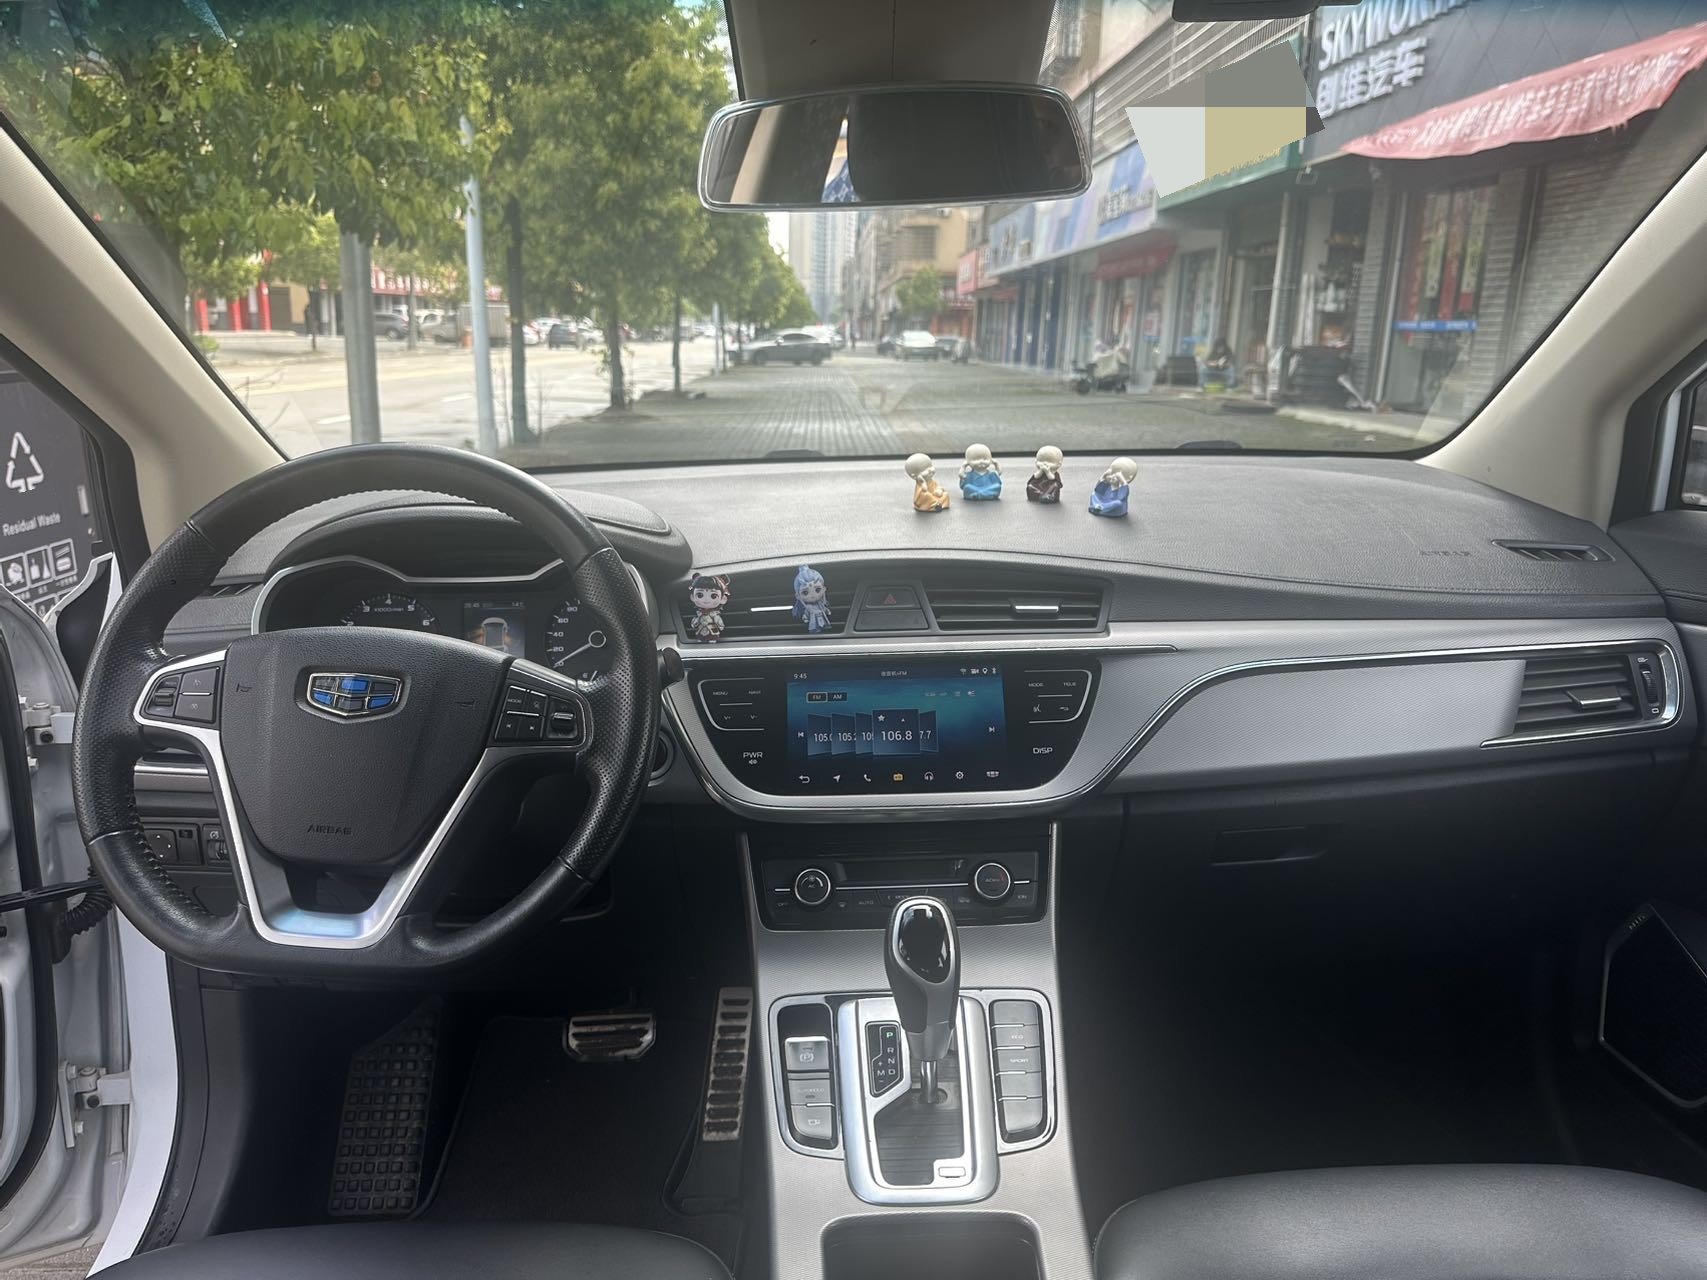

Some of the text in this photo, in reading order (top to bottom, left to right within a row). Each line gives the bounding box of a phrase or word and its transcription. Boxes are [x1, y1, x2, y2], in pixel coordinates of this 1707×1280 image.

[2, 512, 61, 536] Residual Waste
[793, 672, 808, 680] 9:45
[881, 730, 913, 741] 106.8
